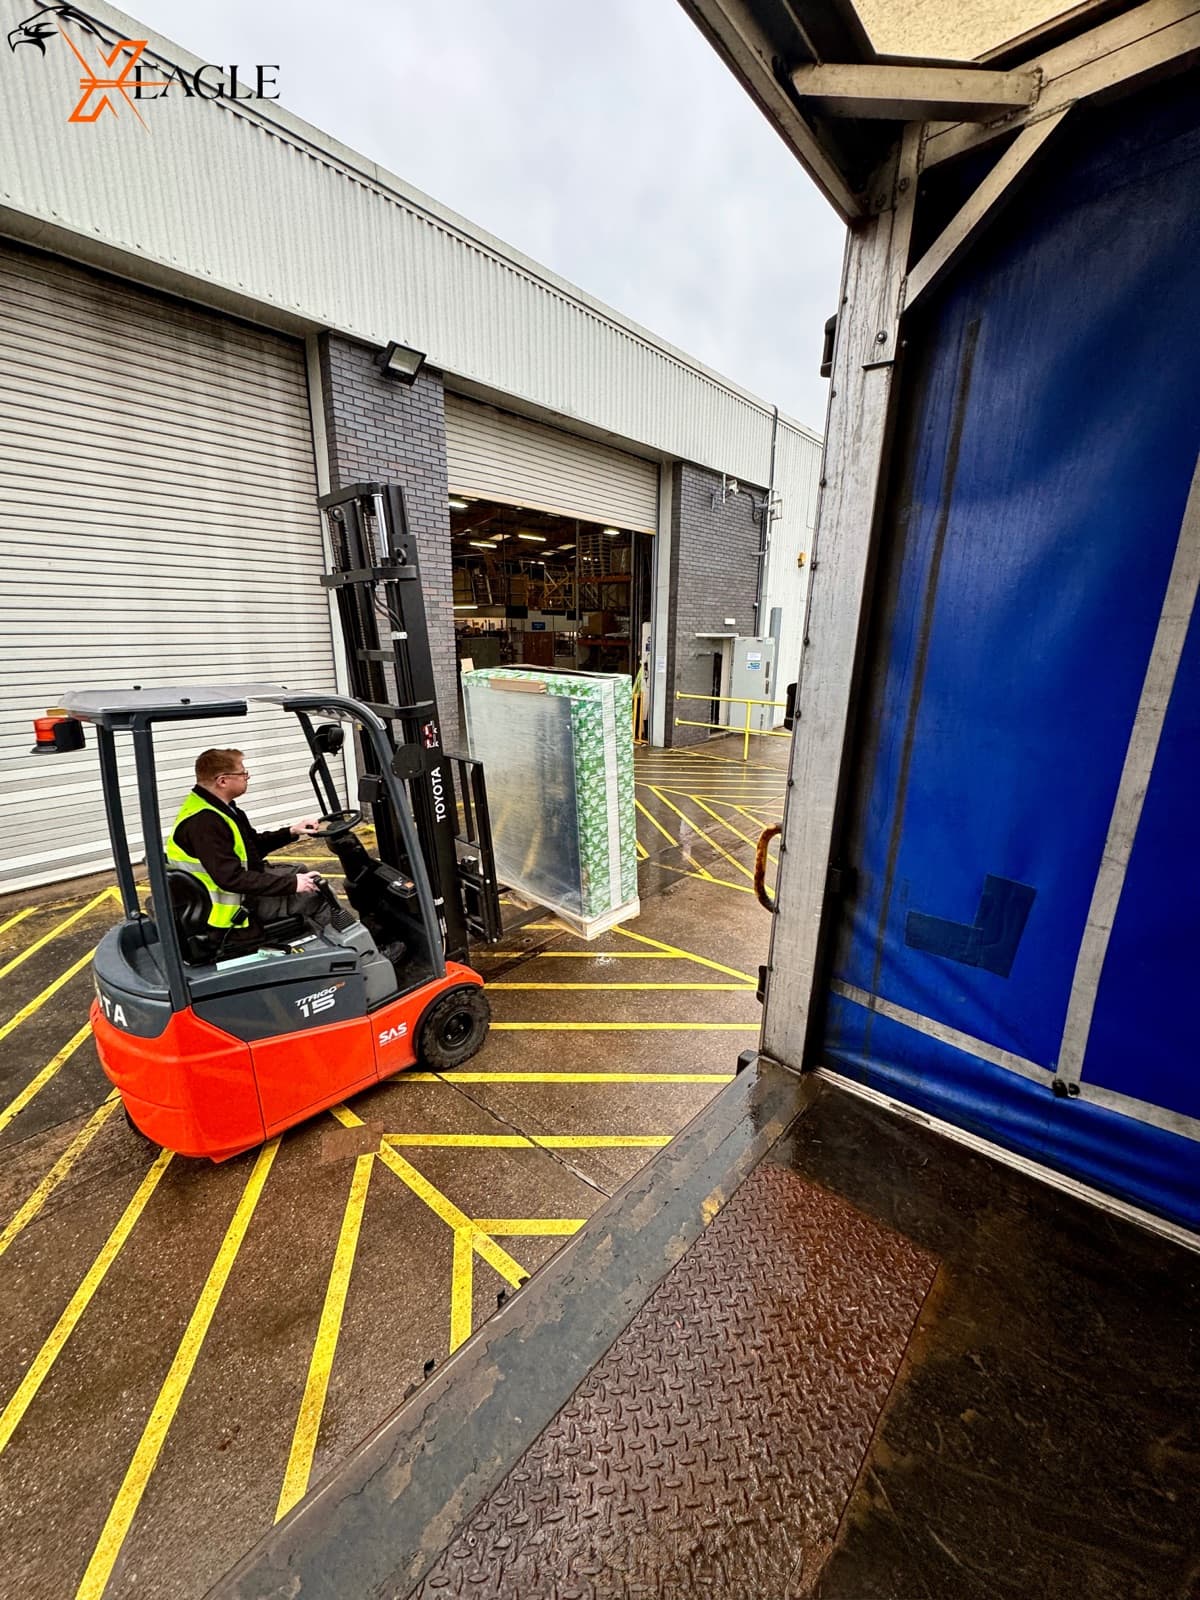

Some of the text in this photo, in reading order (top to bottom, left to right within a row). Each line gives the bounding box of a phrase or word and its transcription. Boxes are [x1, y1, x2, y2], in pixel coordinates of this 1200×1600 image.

[430, 766, 447, 823] TOYOTA
[299, 993, 336, 1018] 15
[378, 1021, 408, 1044] SAS
